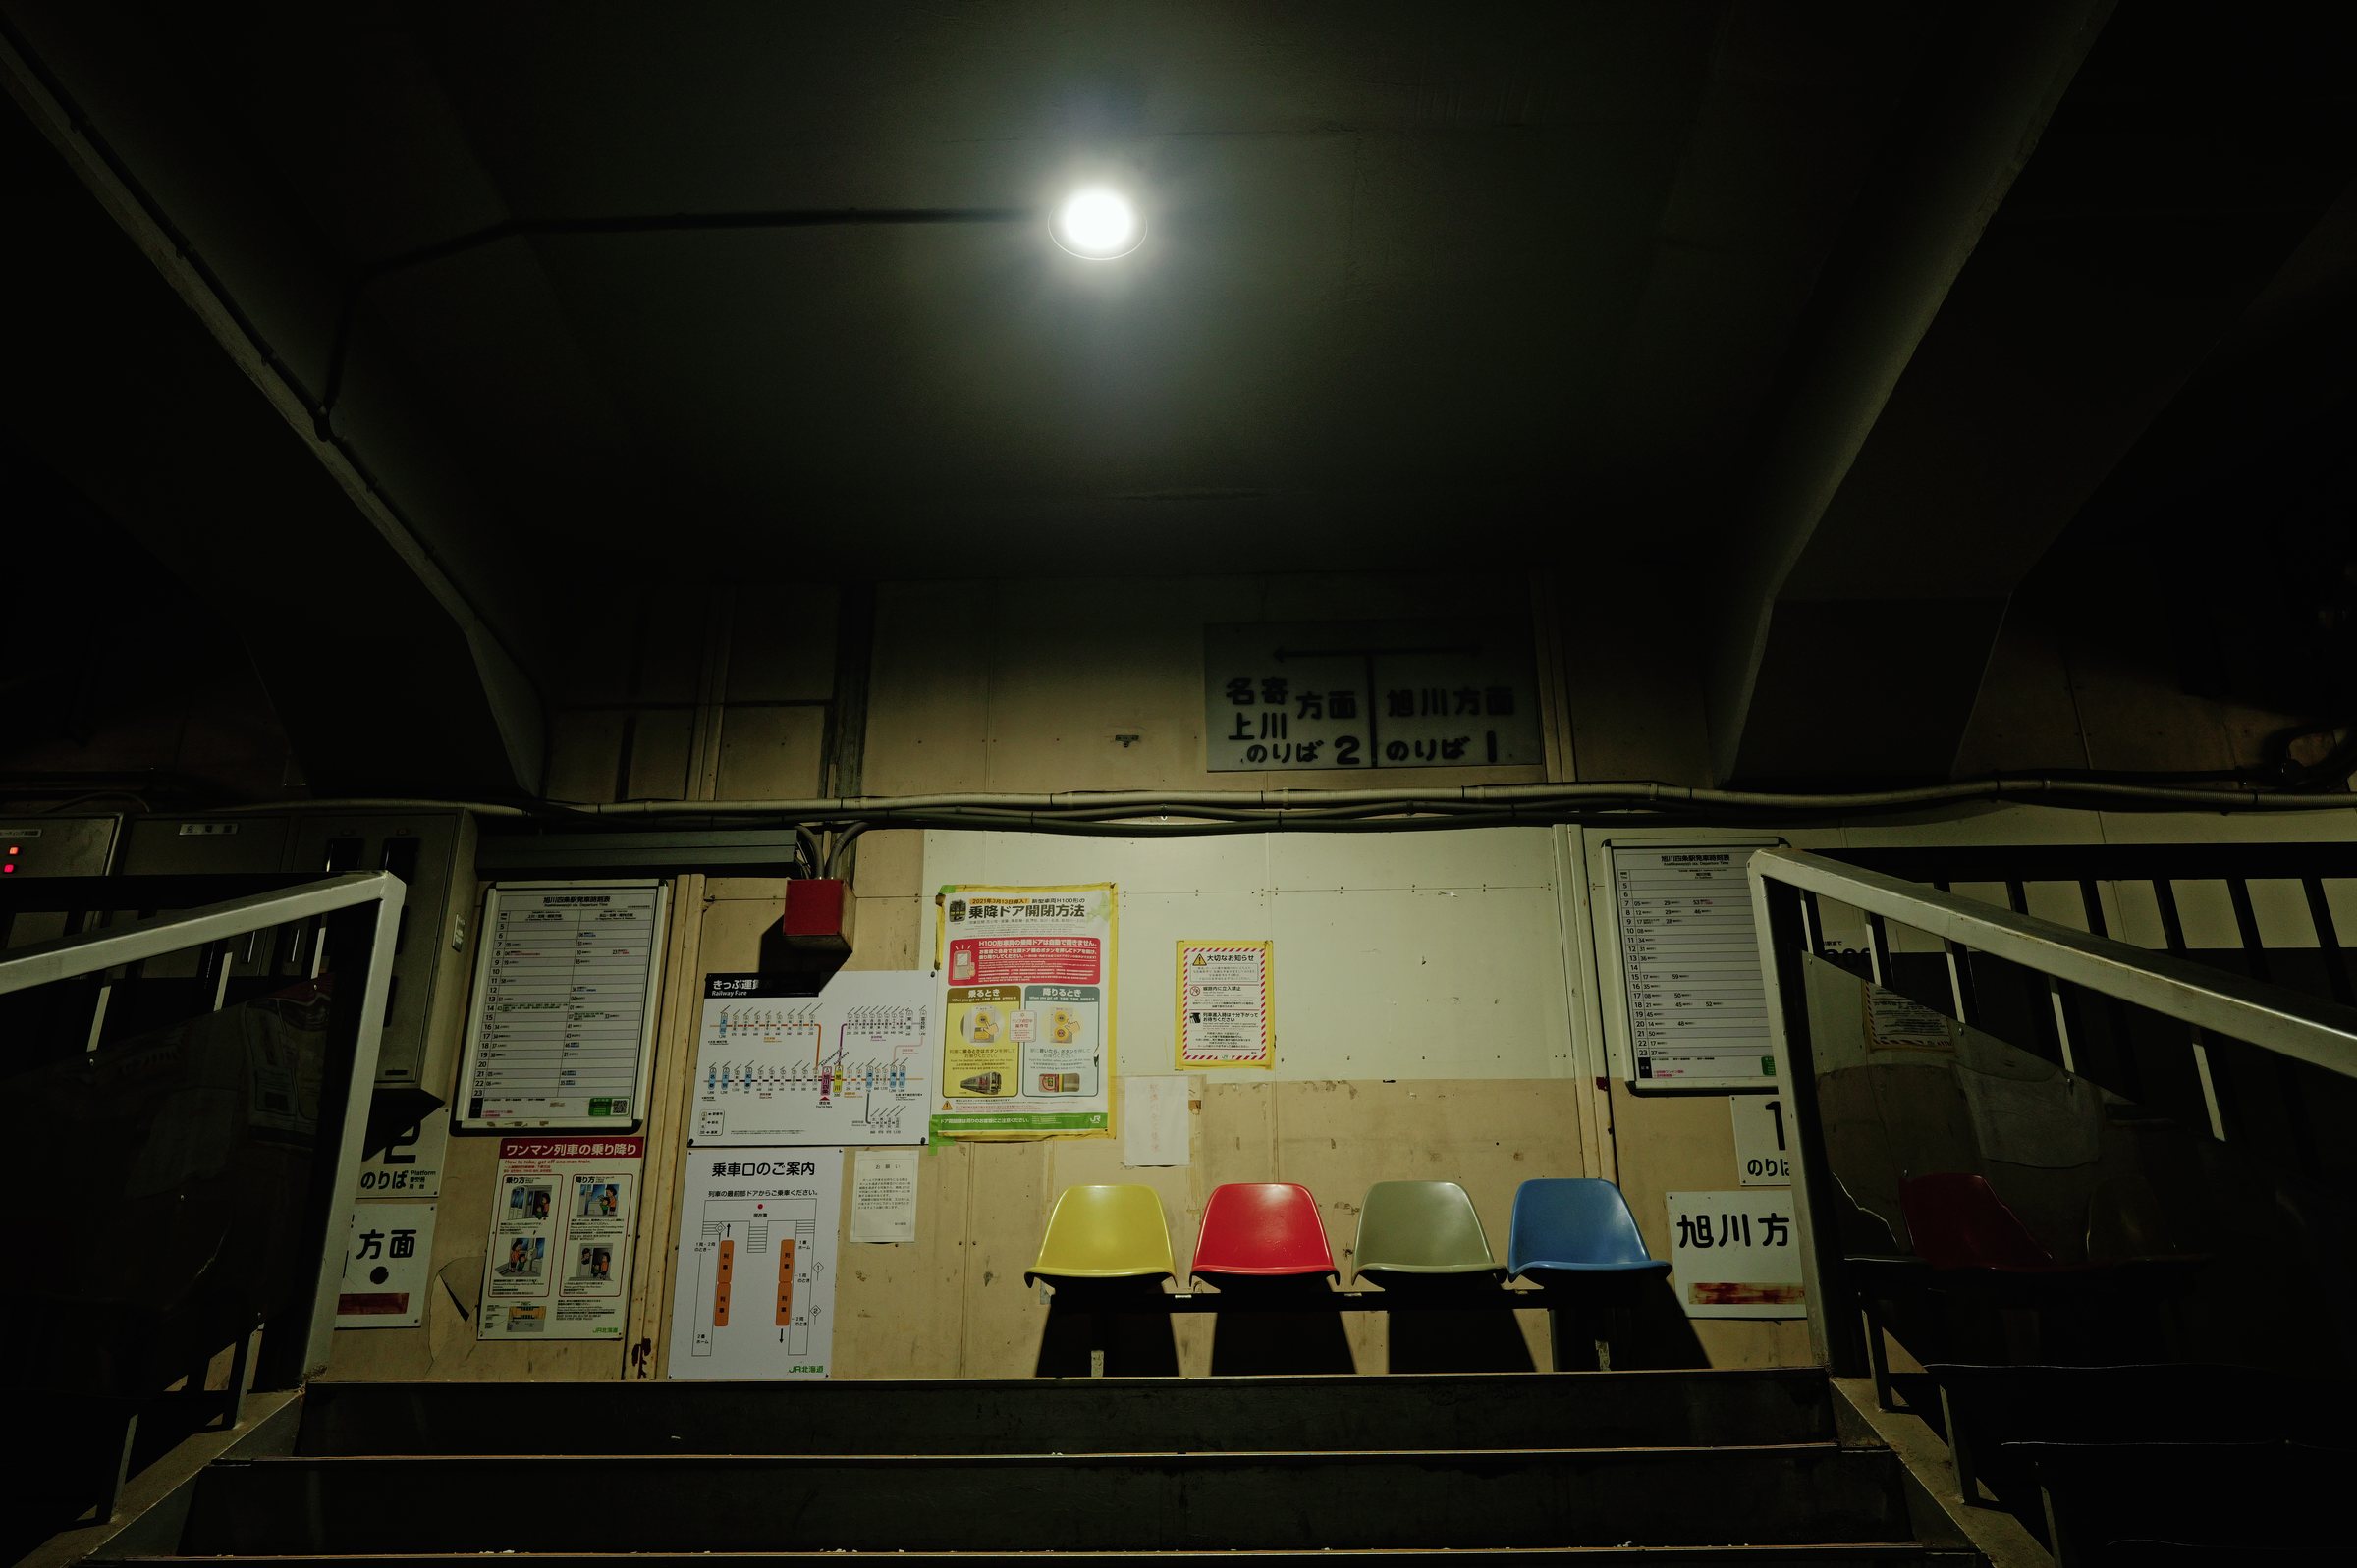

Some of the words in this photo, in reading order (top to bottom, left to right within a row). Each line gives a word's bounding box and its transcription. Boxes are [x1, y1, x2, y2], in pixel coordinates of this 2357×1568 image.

[1227, 677, 1288, 704] 名寄
[1388, 687, 1513, 717] 旭川方面
[1296, 690, 1356, 719] 方面
[1229, 712, 1287, 739] 上川
[1247, 739, 1324, 763] のりば
[1335, 736, 1360, 764] 2
[1386, 736, 1471, 761] のりば
[1487, 730, 1497, 762] 1
[968, 904, 1085, 919] 乗降ドア開閉方法
[1042, 988, 1081, 997] 降りるとき
[1765, 1101, 1785, 1150] 1
[506, 1143, 636, 1157] ワンマン列車の乗り降り
[360, 1170, 409, 1189] のりば
[712, 1162, 815, 1177] 乗車口のご案内
[356, 1229, 416, 1259] 方面
[1677, 1213, 1789, 1248] 旭川方
